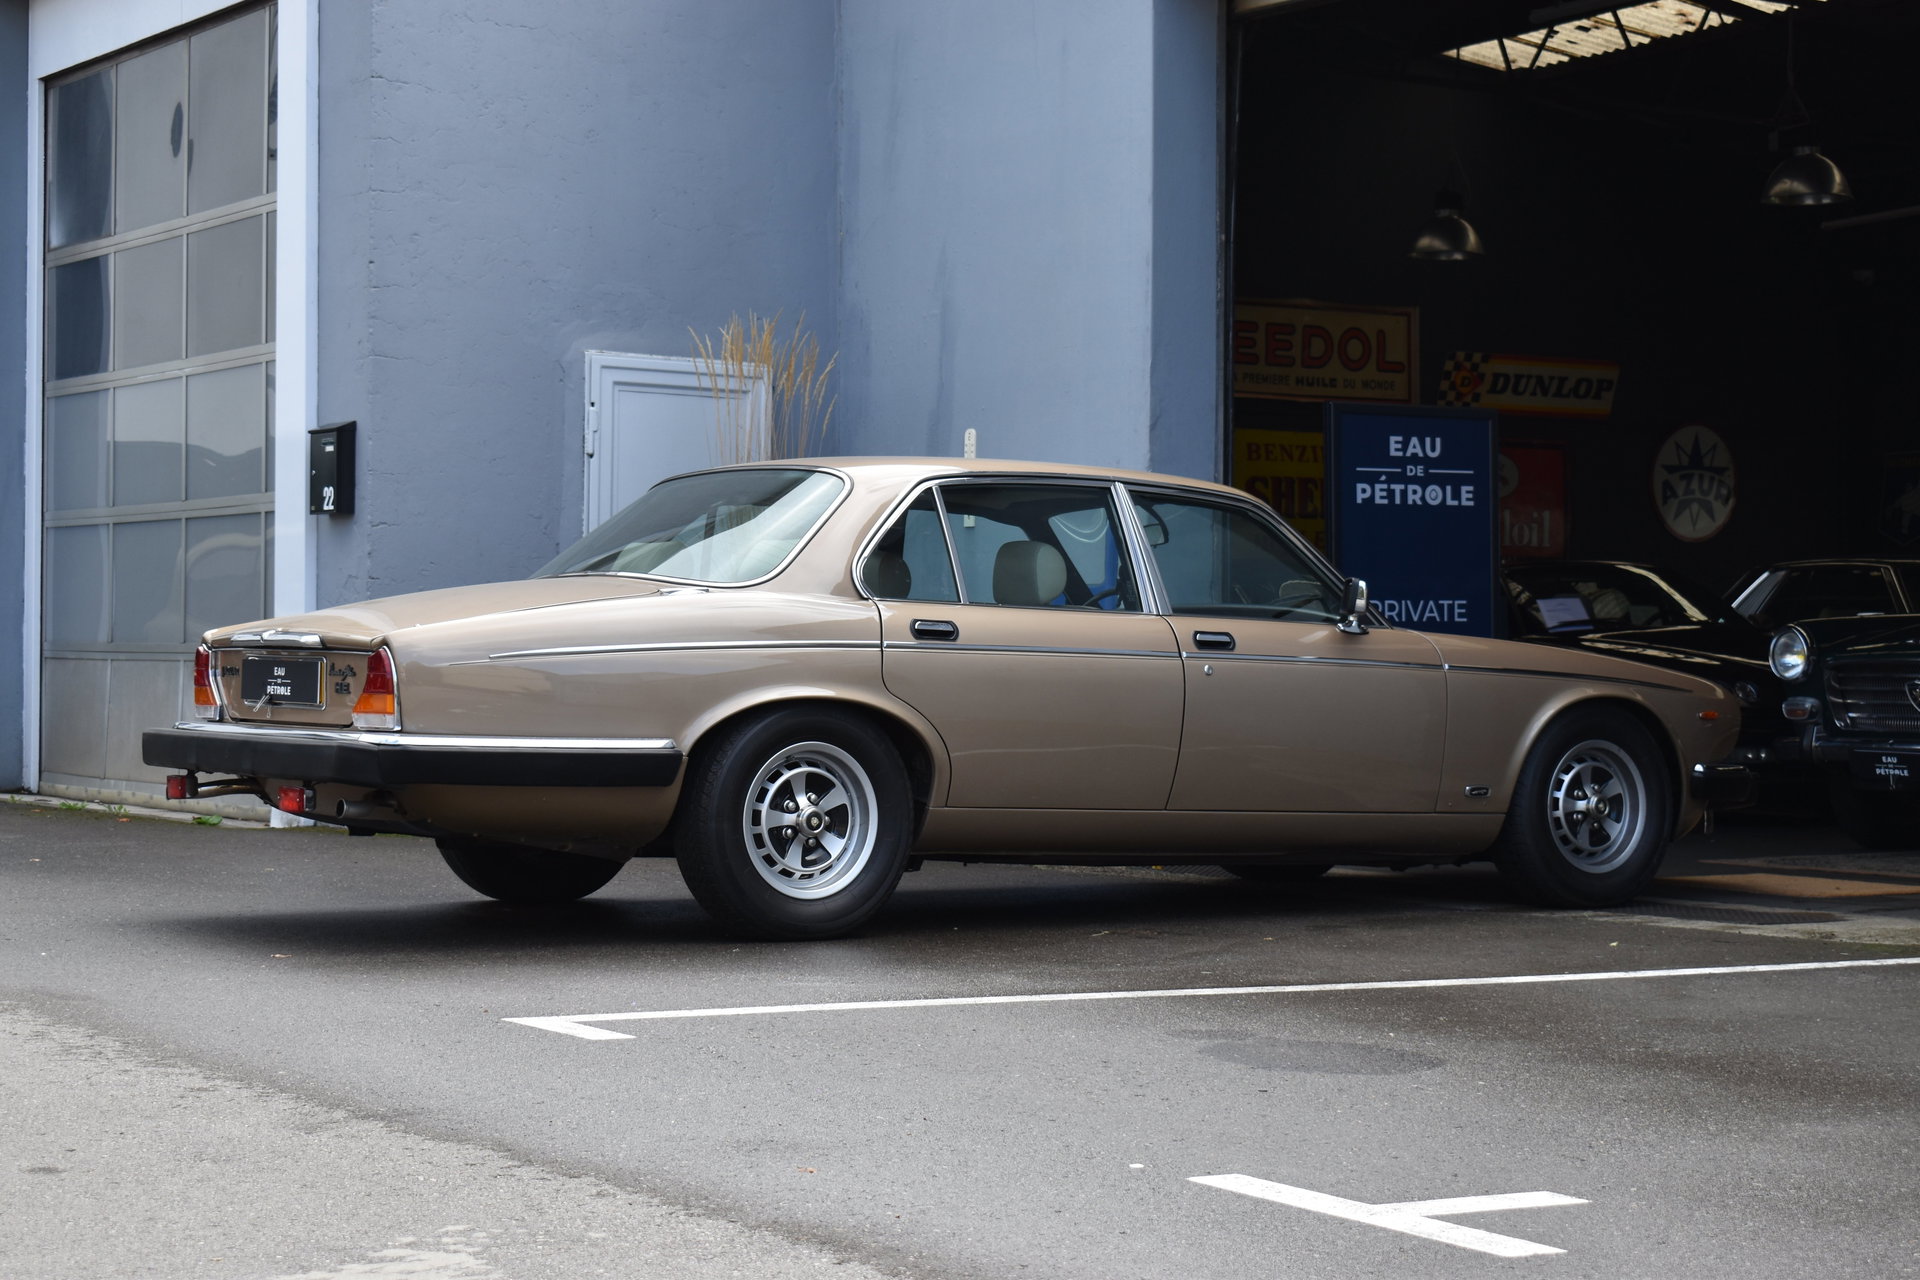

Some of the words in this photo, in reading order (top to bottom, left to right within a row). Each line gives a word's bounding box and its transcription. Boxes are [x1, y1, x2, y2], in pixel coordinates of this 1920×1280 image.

[1295, 376, 1338, 388] HUILE
[1343, 378, 1356, 388] DU
[1361, 379, 1397, 391] MONDE
[1488, 373, 1614, 399] DUNLOP
[1246, 442, 1325, 464] BENZI
[1389, 435, 1442, 458] EAU
[1406, 465, 1425, 477] DE
[323, 486, 335, 511] 22
[1244, 475, 1325, 518] SHE
[1355, 475, 1475, 506] PÉTROLE
[274, 666, 286, 676] EAU
[267, 682, 291, 695] PÉTROLE
[1881, 755, 1898, 764] EAU
